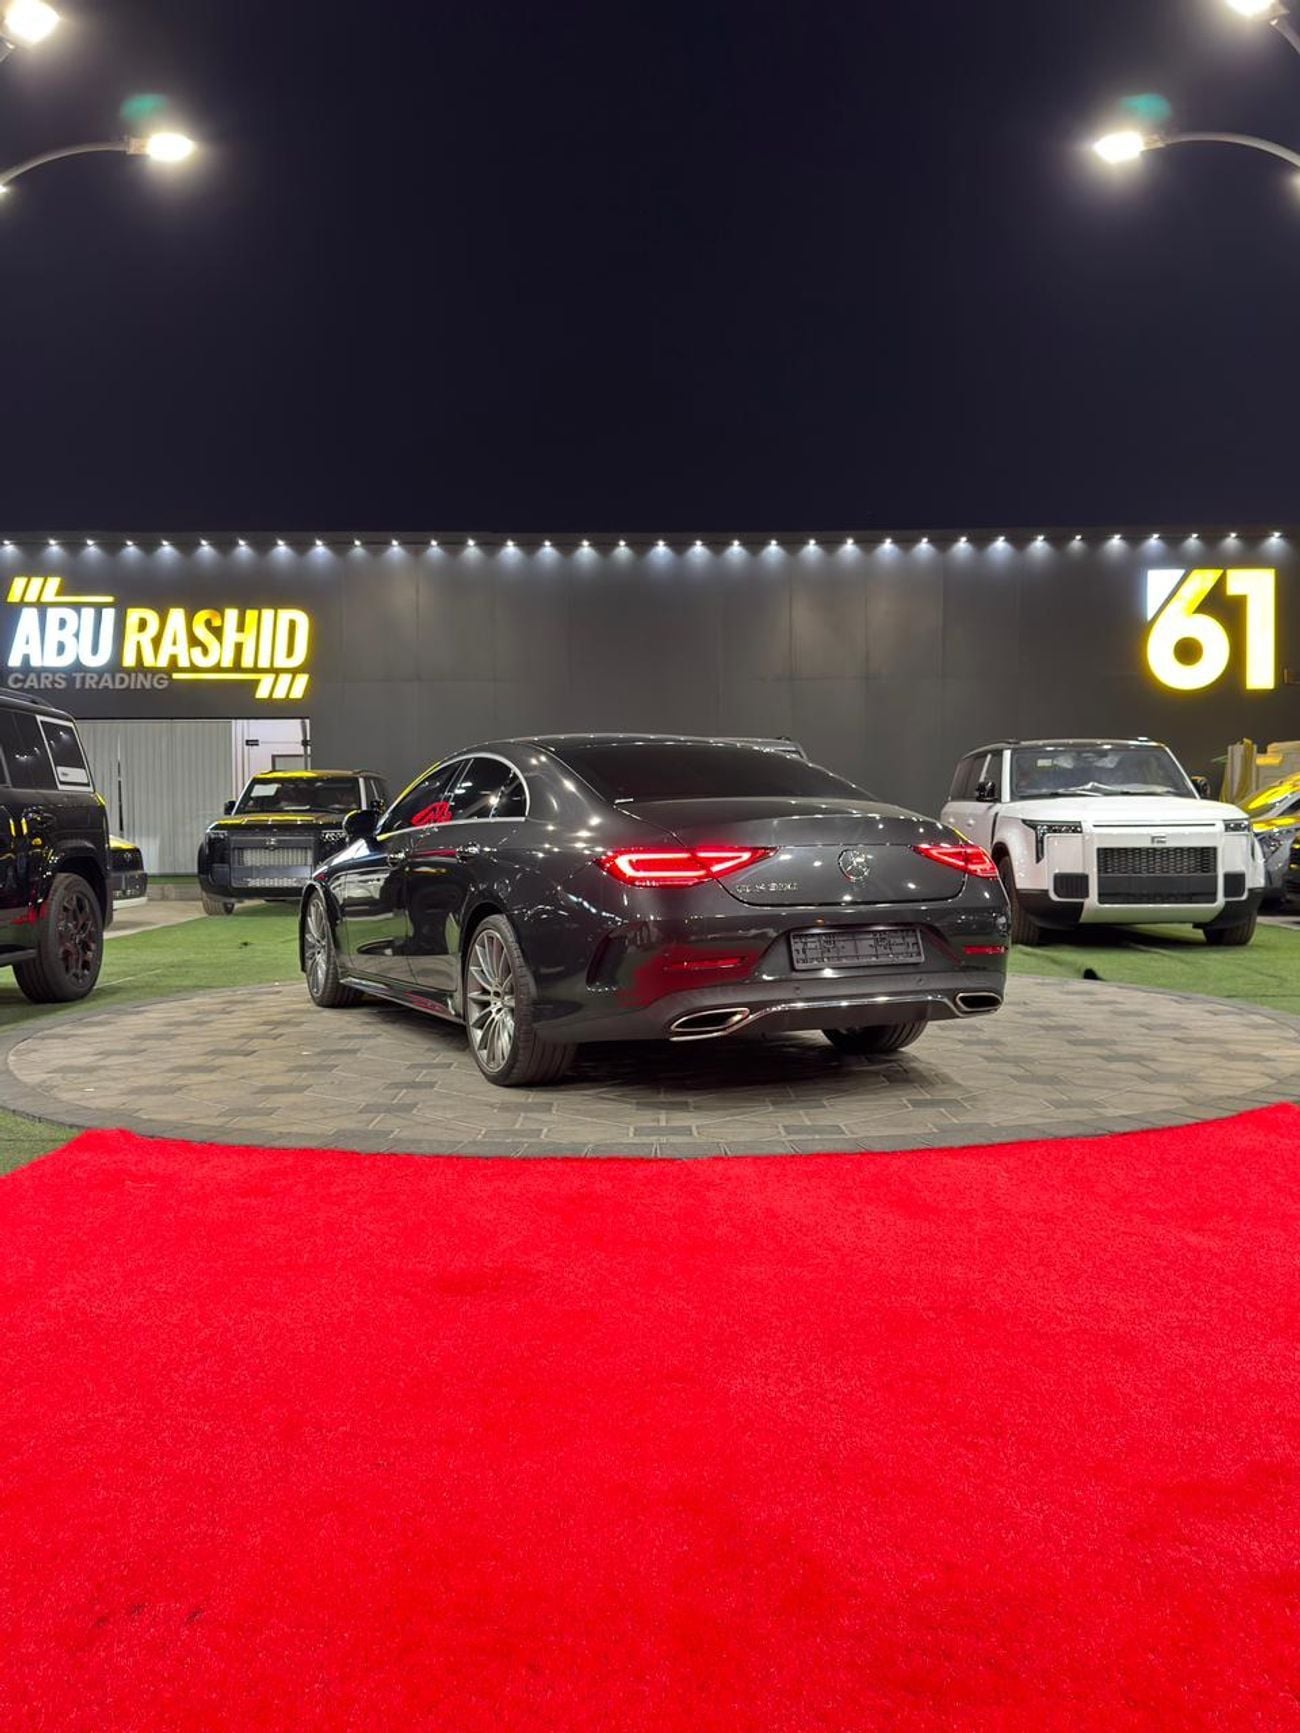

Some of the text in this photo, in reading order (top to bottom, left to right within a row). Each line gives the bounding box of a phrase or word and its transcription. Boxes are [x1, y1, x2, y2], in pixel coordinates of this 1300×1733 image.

[8, 607, 310, 669] ABU RASHID
[1146, 568, 1275, 691] 61
[8, 672, 169, 690] CARS TRADING
